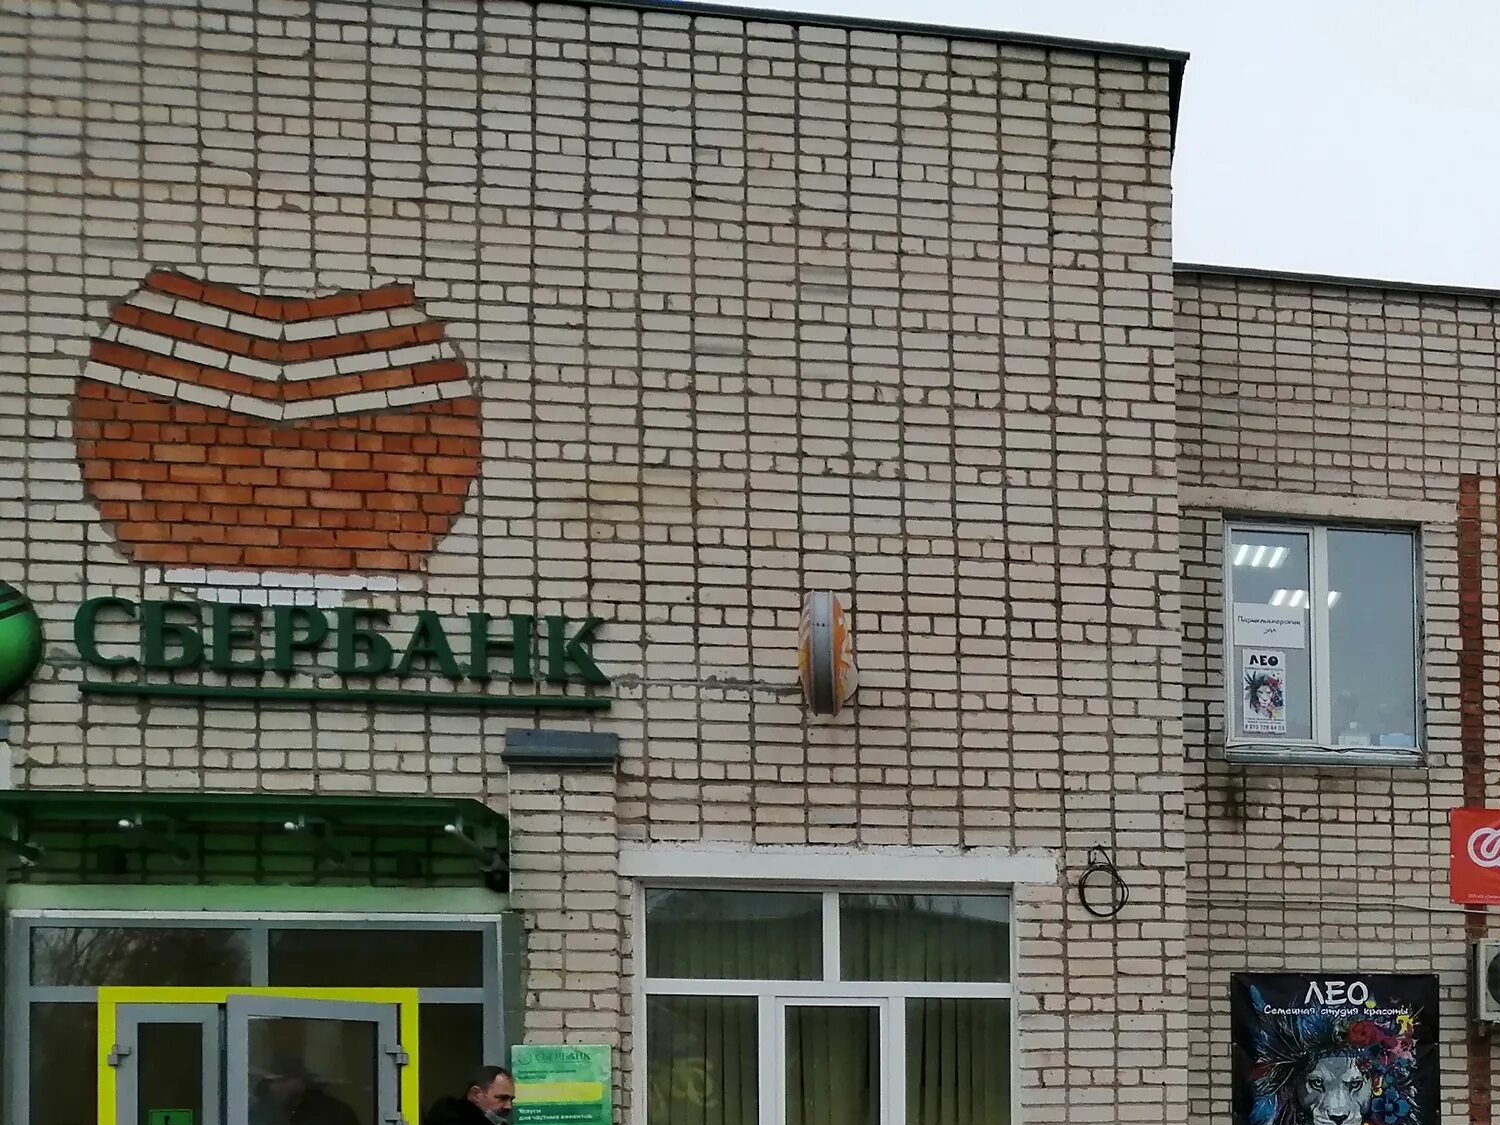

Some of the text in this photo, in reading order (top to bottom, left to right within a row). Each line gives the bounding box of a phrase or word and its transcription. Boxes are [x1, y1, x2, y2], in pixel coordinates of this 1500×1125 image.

[74, 596, 611, 686] СБЕРБАНК
[1250, 654, 1279, 666] ЛЕО
[1304, 981, 1368, 1005] ЛЕО
[1320, 1007, 1359, 1018] студия
[1363, 1004, 1409, 1016] красоты
